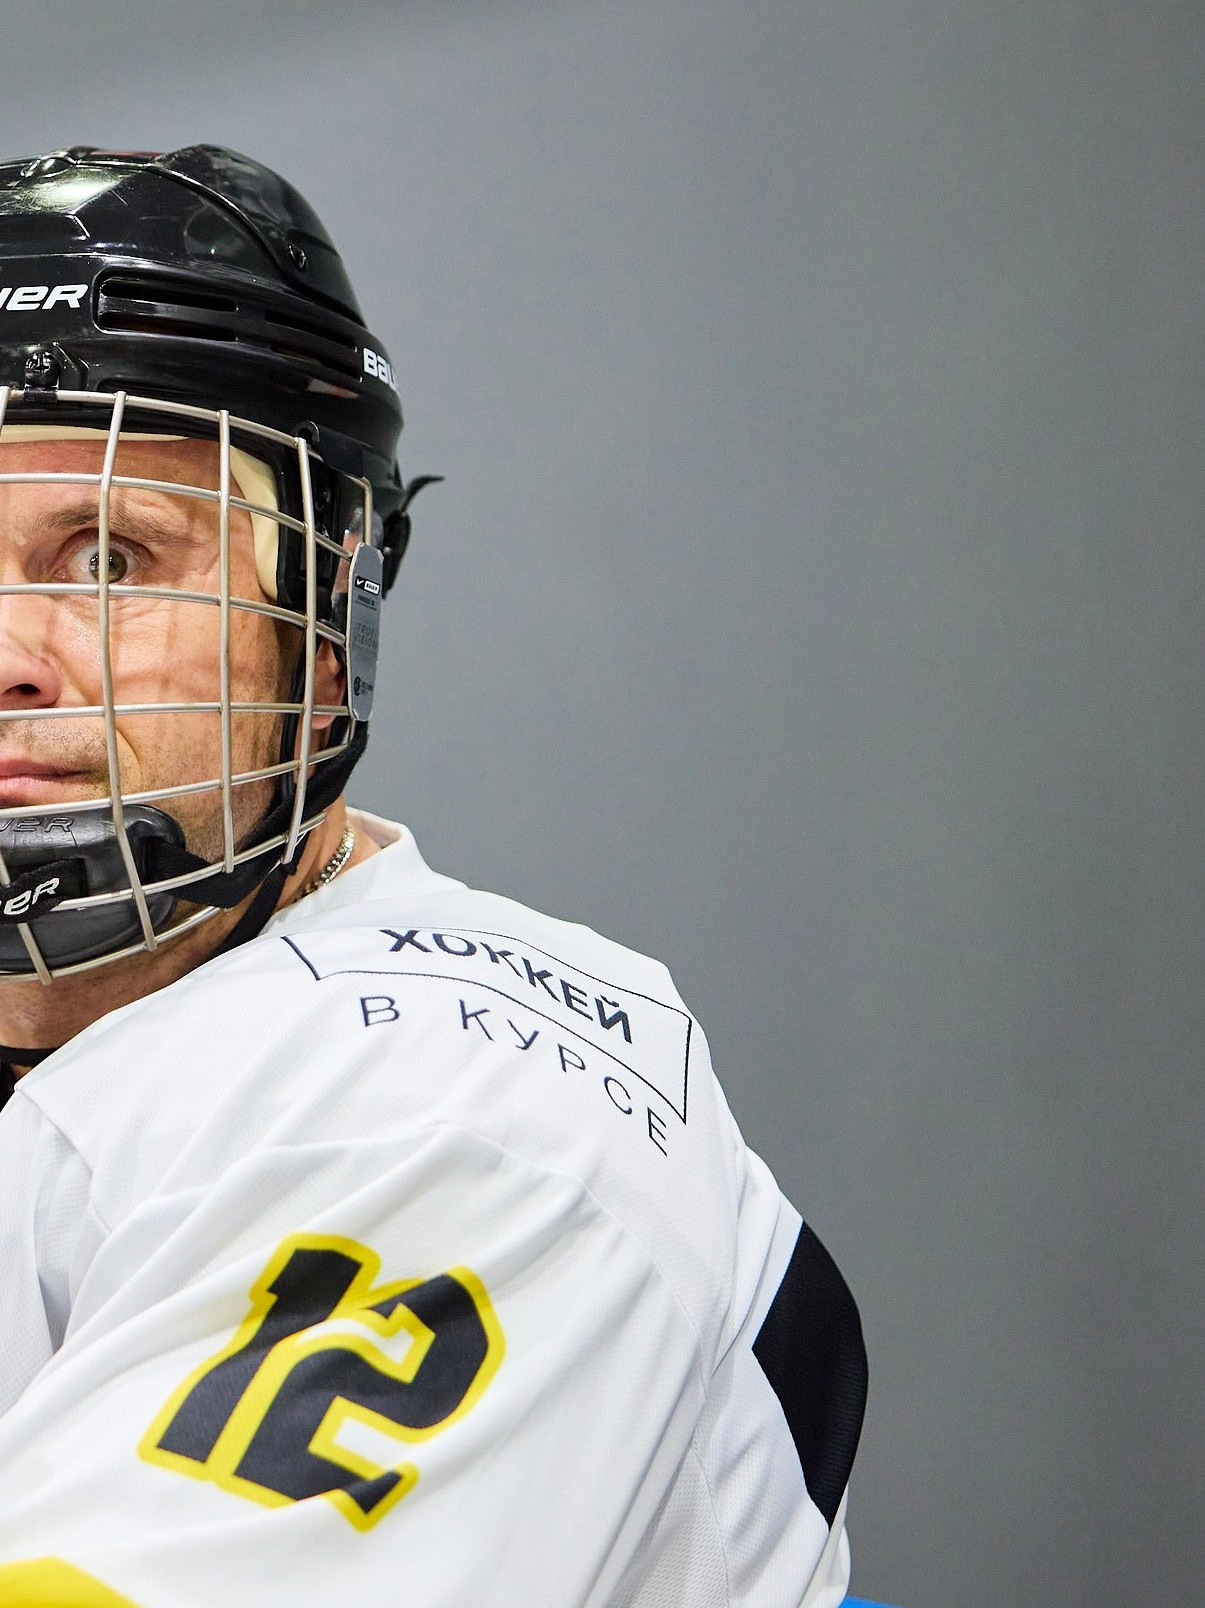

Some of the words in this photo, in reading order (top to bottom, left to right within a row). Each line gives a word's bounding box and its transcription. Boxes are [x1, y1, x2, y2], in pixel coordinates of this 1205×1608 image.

[379, 928, 633, 1045] ХОККЕЙ
[359, 995, 400, 1028] В
[458, 999, 668, 1157] КУРСЕ
[137, 1232, 507, 1534] 12
